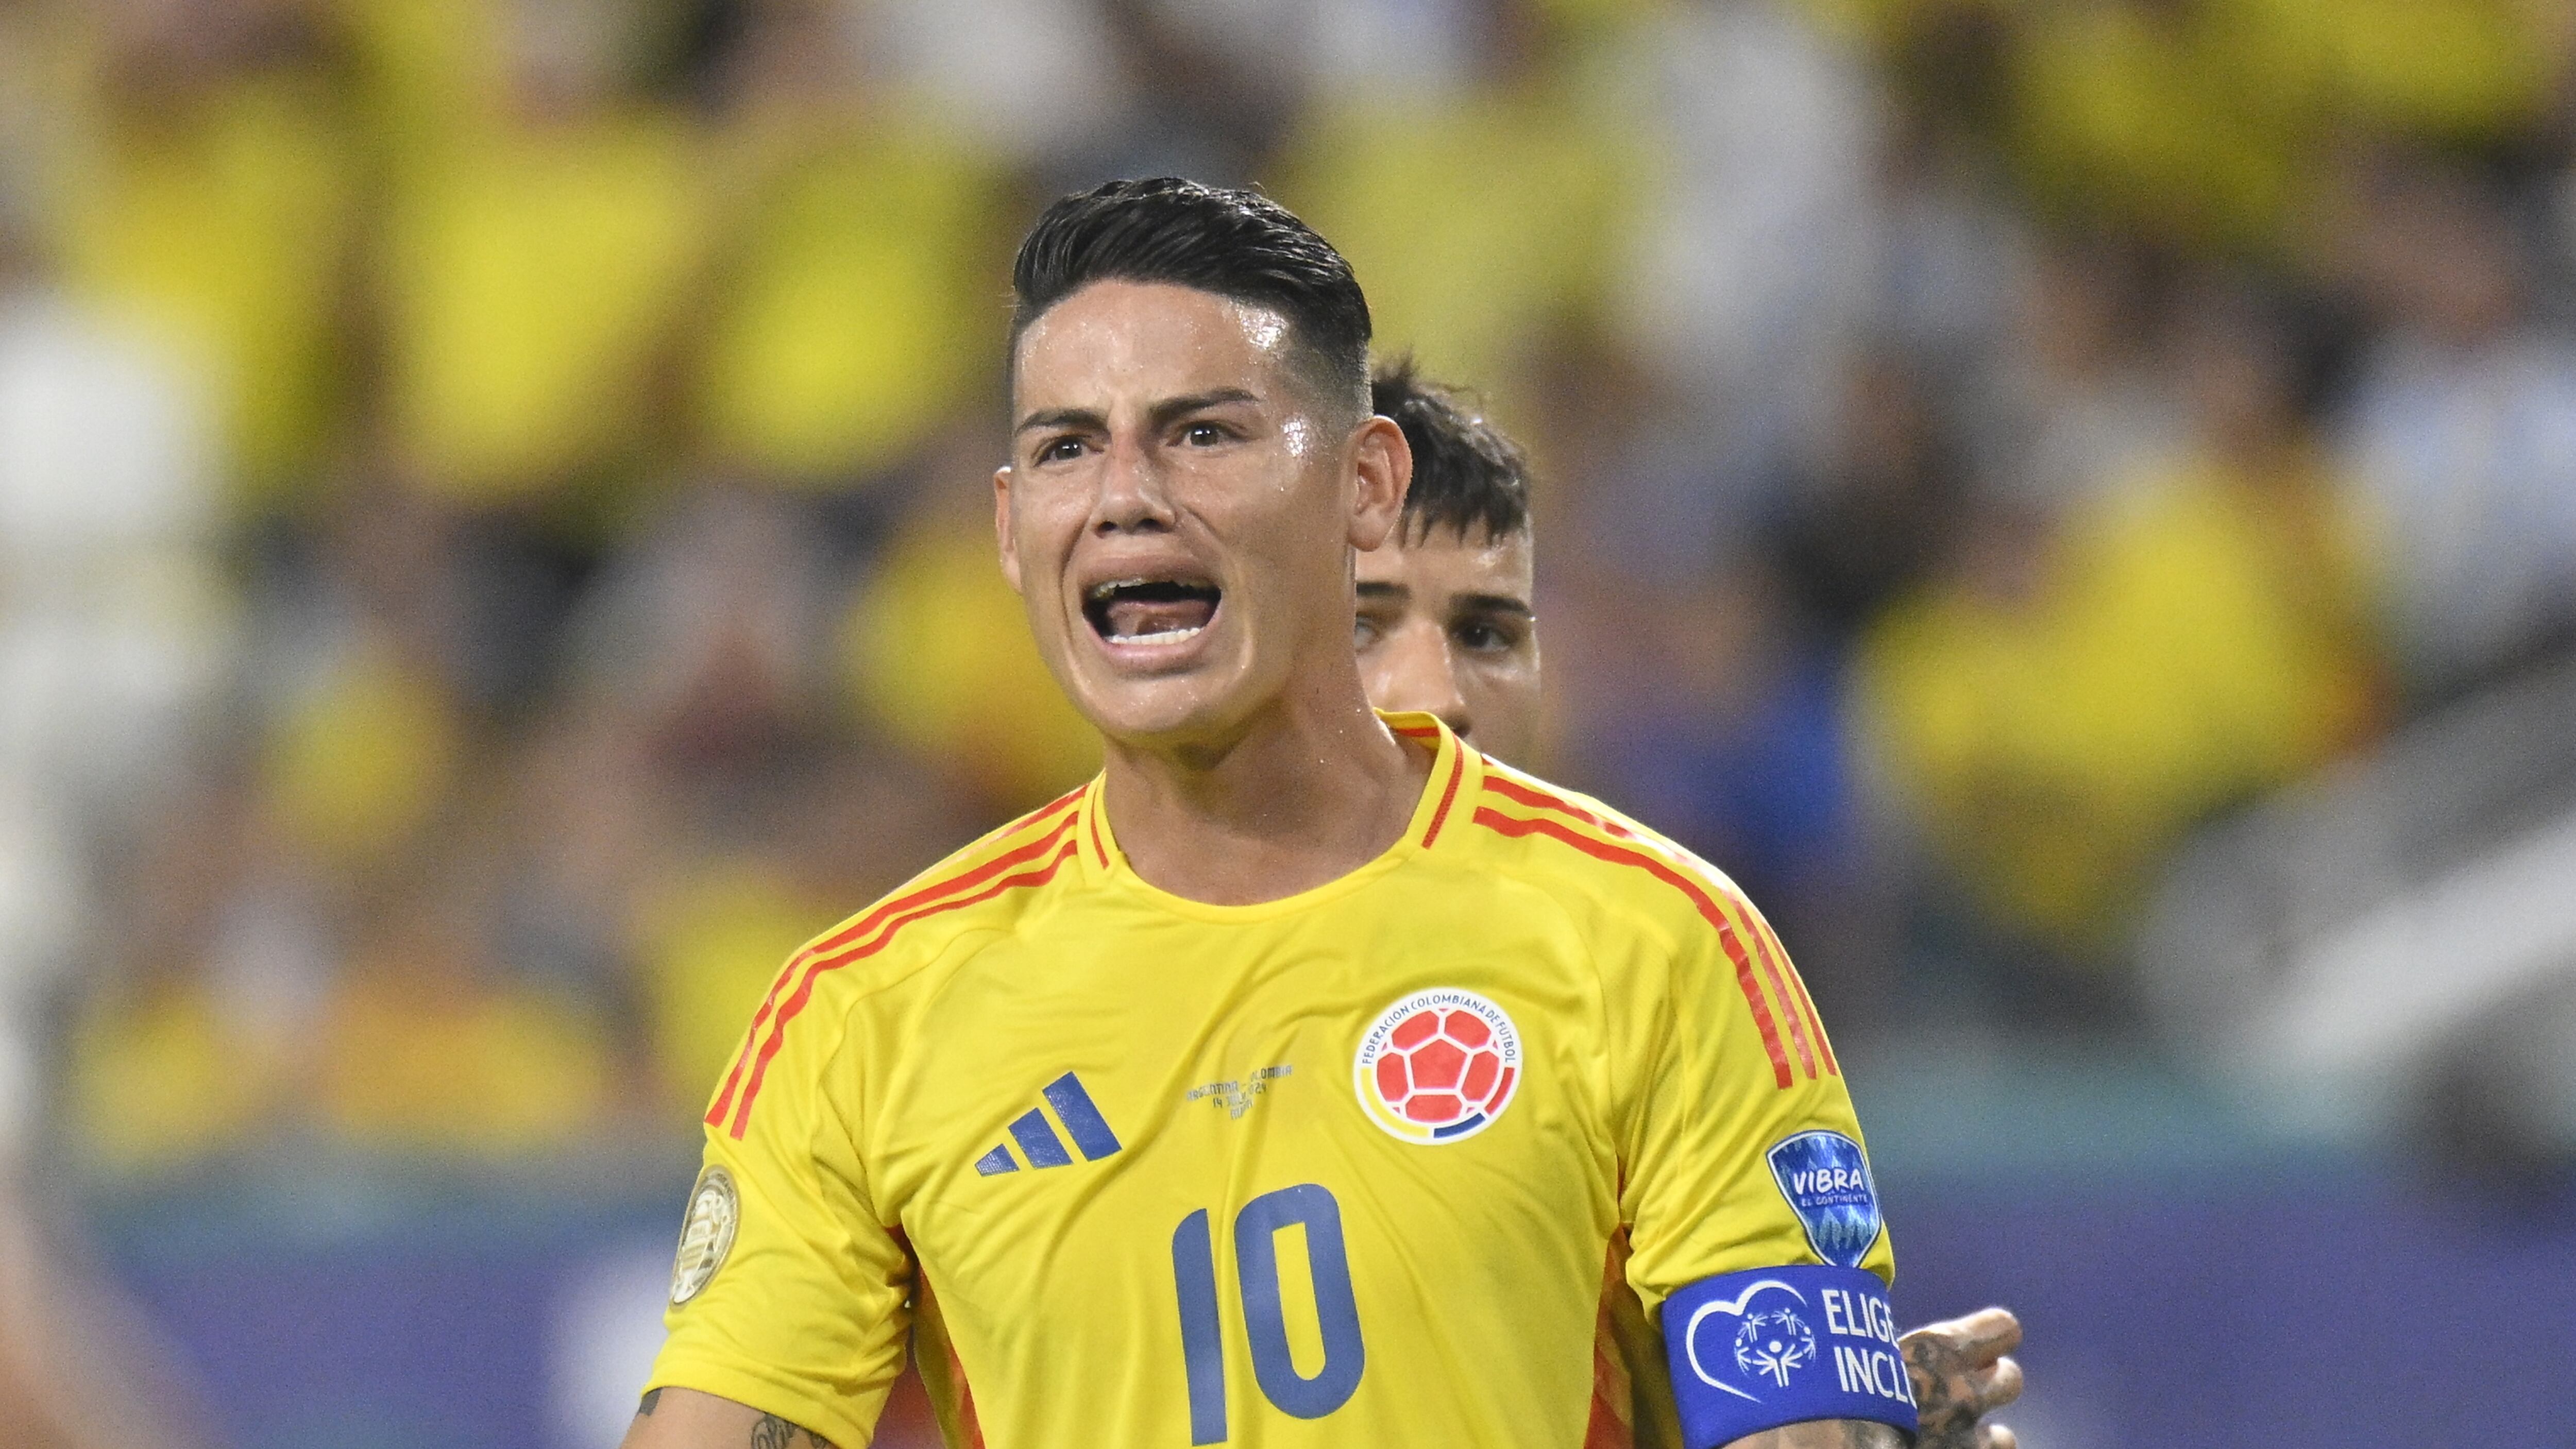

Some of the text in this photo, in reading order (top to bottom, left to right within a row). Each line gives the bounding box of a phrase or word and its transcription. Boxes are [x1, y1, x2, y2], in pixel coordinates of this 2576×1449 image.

[1411, 994, 1487, 1014] COLOMBIANA
[1485, 1010, 1500, 1024] DE
[1793, 1168, 1865, 1195] VIBRA
[1171, 1183, 1365, 1446] 10
